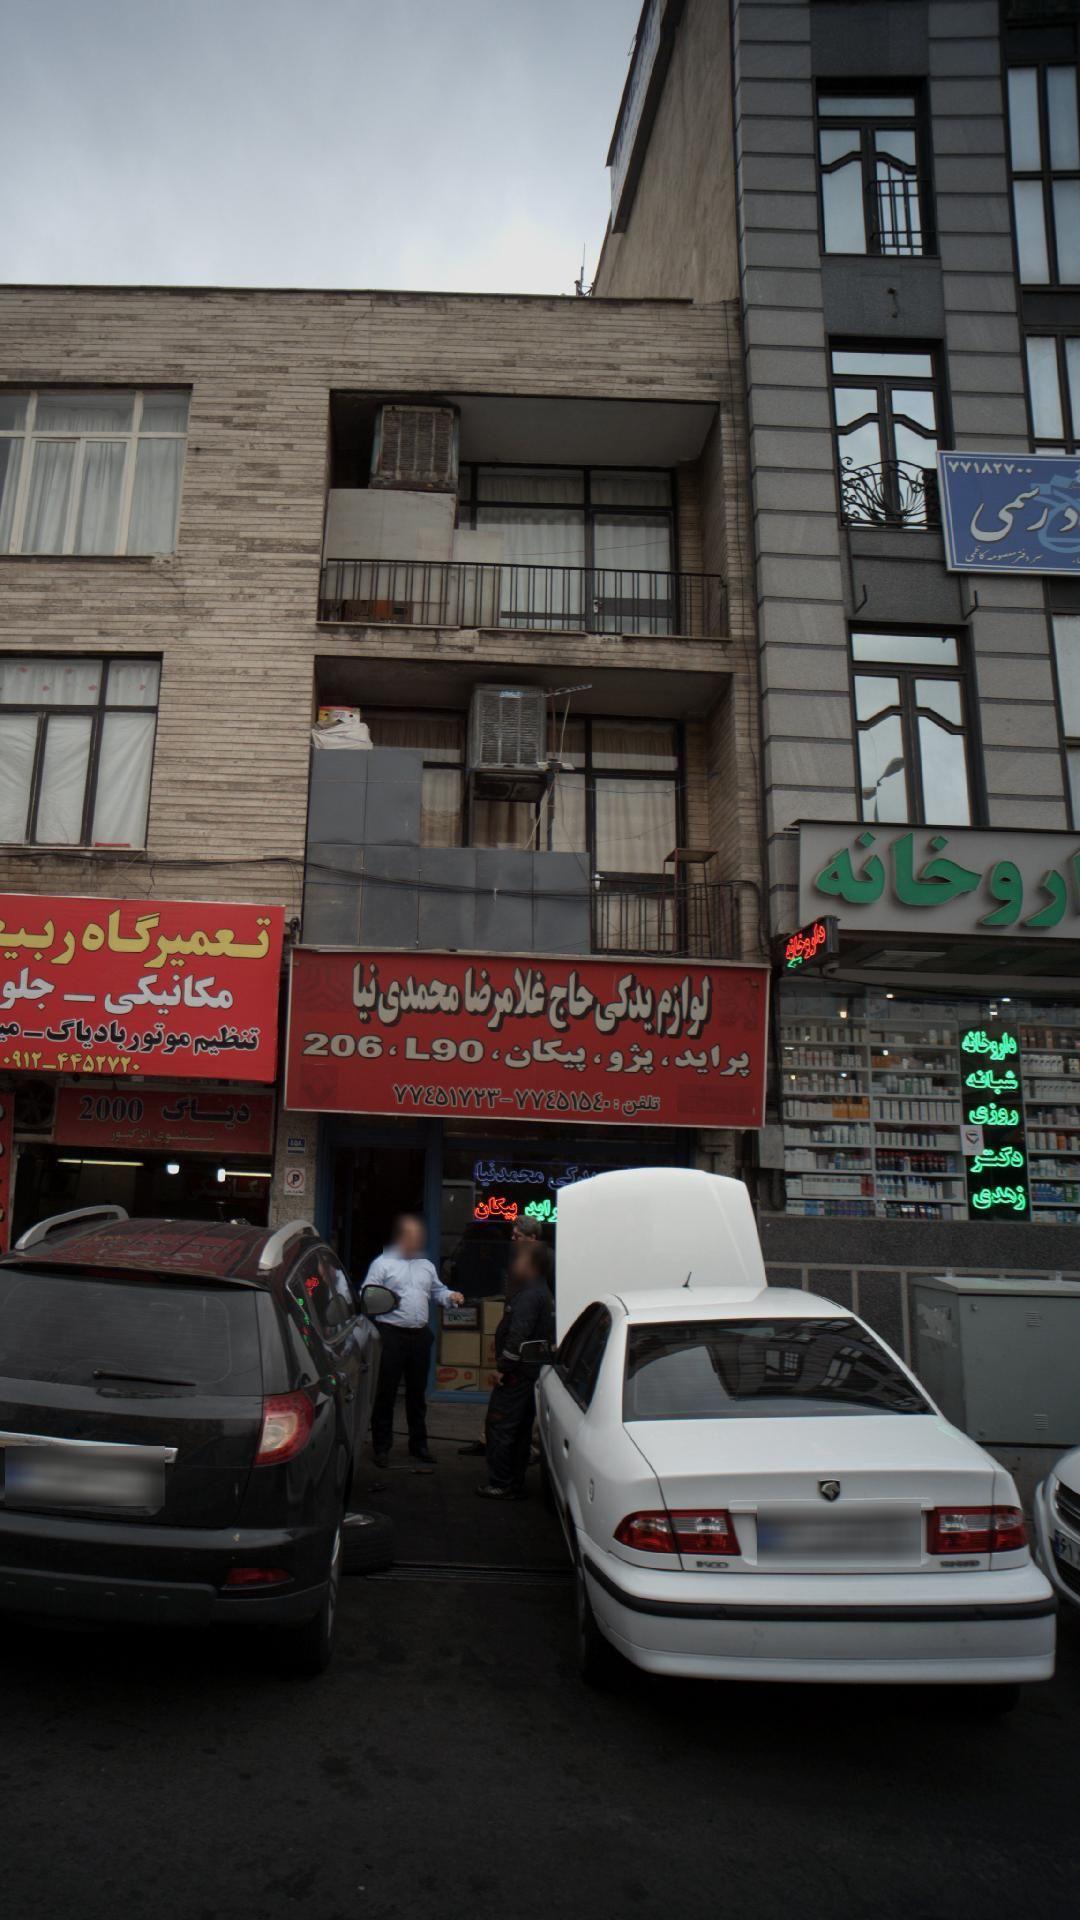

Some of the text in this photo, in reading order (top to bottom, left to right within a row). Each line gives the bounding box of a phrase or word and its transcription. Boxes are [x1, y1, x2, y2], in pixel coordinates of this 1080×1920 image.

[814, 830, 1080, 928] روخانه
[81, 908, 271, 969] تعمیرگاه
[103, 973, 235, 1015] مکانیکی
[351, 960, 713, 1037] لوازم یدکی حاج غلامرضا محمدی نیا
[126, 1022, 192, 1054] موتور
[193, 1025, 260, 1056] تنظیم
[303, 1032, 384, 1059] 206
[961, 1030, 1018, 1061] داروخانه
[965, 1069, 1019, 1096] شبانه
[79, 1094, 145, 1124] 2000
[968, 1102, 1019, 1126] روزی
[969, 1146, 1025, 1173] دکتر
[473, 1195, 558, 1223] راید پیکان
[972, 1185, 1026, 1211] زهدی
